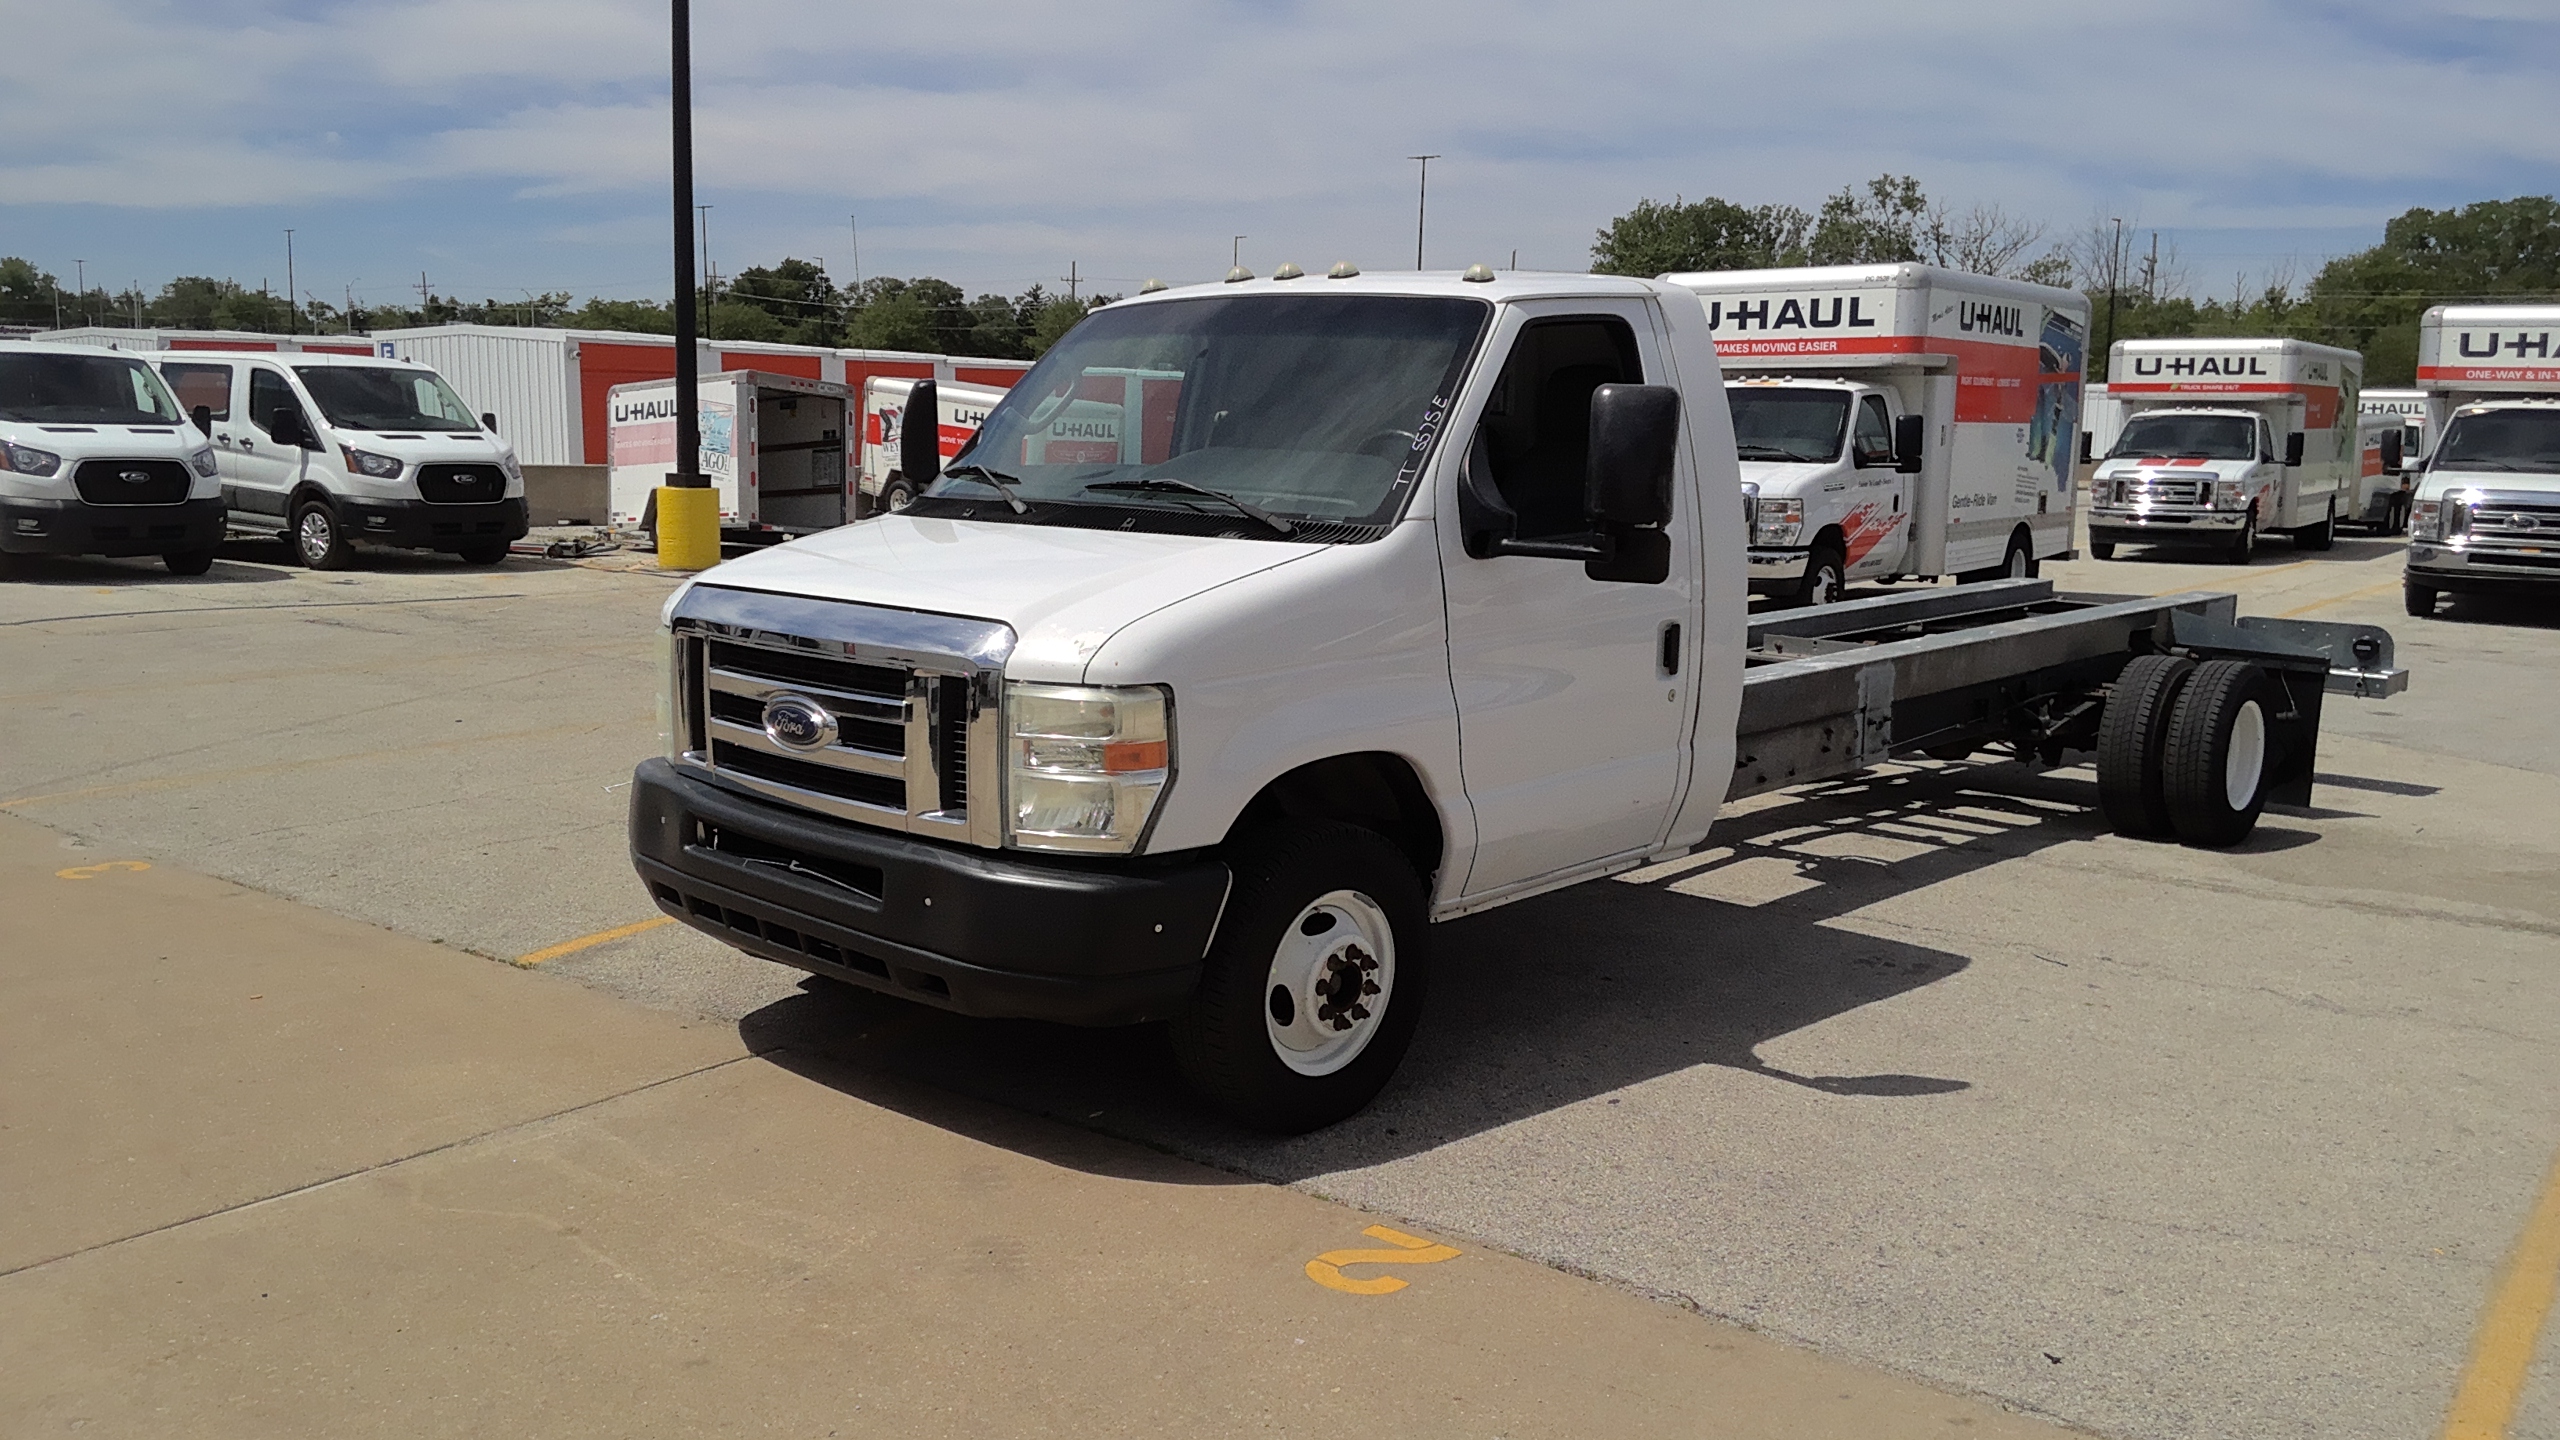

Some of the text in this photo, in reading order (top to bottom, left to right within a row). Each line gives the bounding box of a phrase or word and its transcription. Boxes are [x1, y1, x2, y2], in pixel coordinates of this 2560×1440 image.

[1960, 301, 2024, 337] U-HAUL
[1714, 341, 1837, 353] MAKES MOVING EASIER
[2459, 332, 2560, 358] U-H
[2135, 357, 2267, 376] U-HAUL
[2466, 370, 2522, 379] ONE-WAY
[2525, 370, 2535, 379] &
[615, 399, 677, 422] U-HAUL
[955, 408, 985, 425] U-H
[1053, 422, 1115, 438] U-HAUL
[882, 442, 900, 454] WEY
[774, 708, 806, 736] Ford
